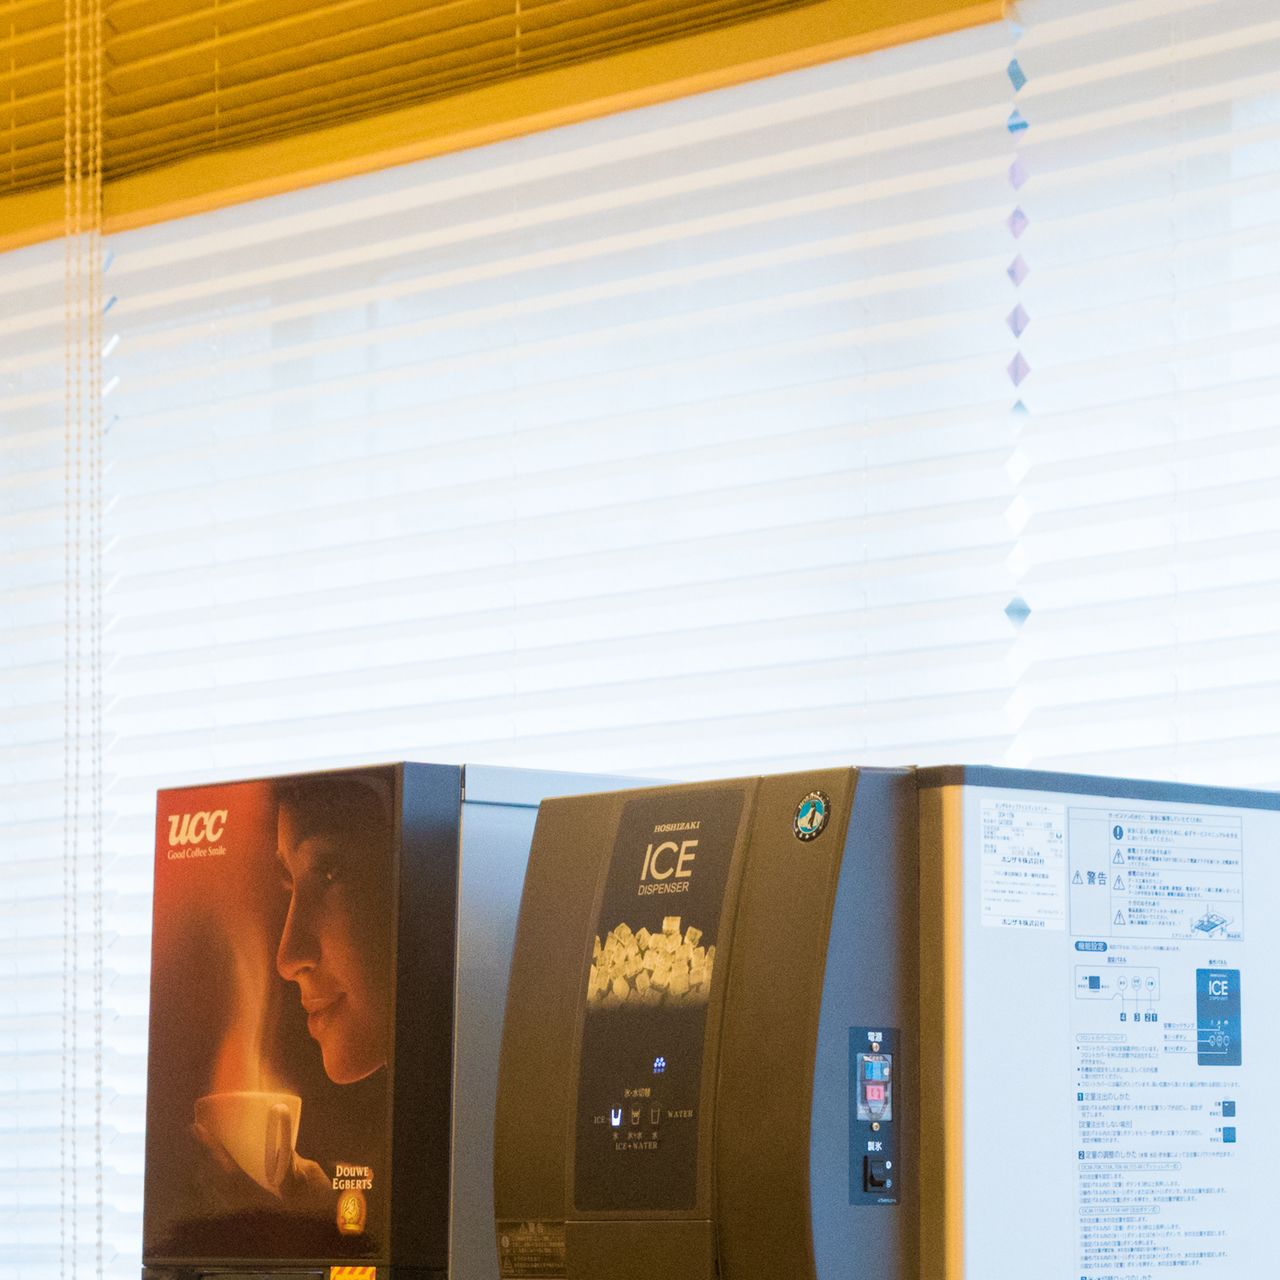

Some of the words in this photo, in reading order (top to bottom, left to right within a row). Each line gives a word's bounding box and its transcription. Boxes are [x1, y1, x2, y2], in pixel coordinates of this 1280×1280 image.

[654, 821, 700, 832] HOSHIZAKI
[168, 850, 185, 860] Good
[186, 848, 207, 858] Coffee
[208, 846, 226, 856] Smile
[640, 840, 699, 880] ICE
[1086, 871, 1108, 886] 警告
[637, 881, 690, 896] DISPENSER
[1209, 980, 1229, 996] ICE
[667, 1109, 694, 1119] WATER
[336, 1165, 369, 1177] DOUWE
[332, 1178, 373, 1190] EGBERTS
